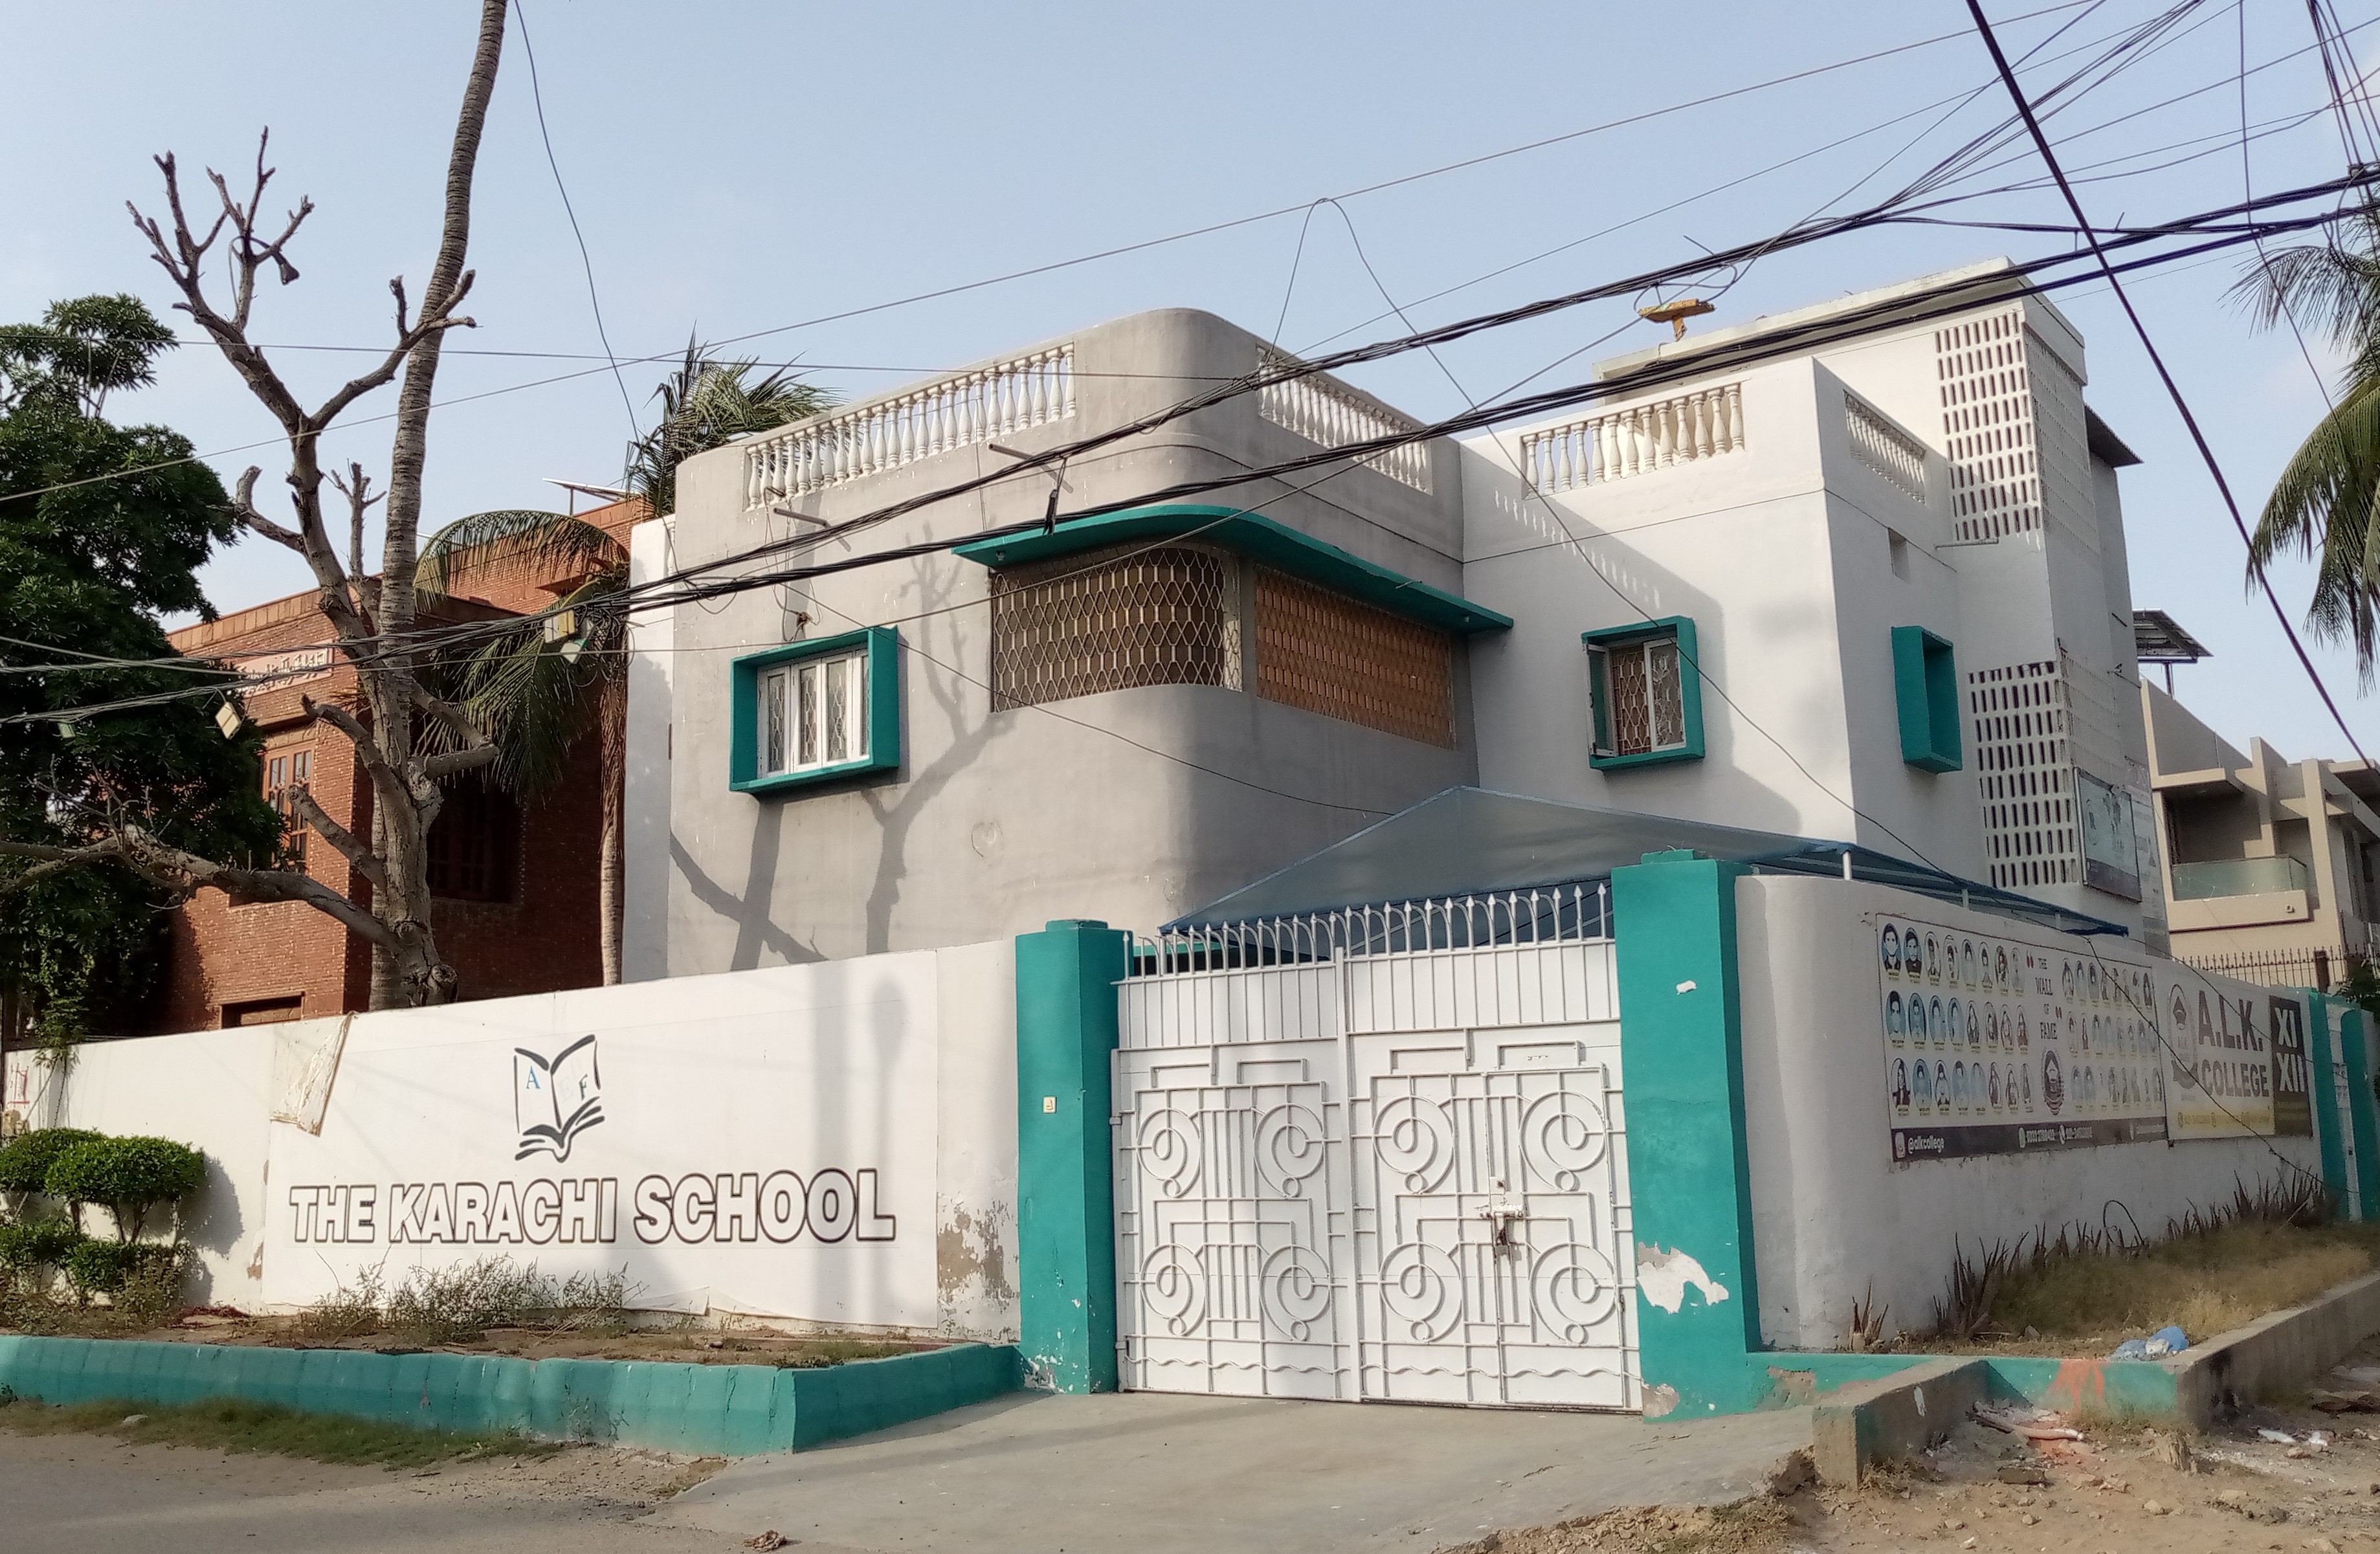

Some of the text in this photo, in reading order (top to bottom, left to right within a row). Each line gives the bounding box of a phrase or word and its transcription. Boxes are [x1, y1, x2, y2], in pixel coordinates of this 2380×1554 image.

[2035, 977, 2053, 995] WALL
[2040, 1021, 2058, 1039] FAME
[2198, 990, 2263, 1052] A.L.K.
[2274, 1006, 2298, 1049] XI
[526, 1065, 540, 1089] A
[579, 1073, 588, 1101] F
[2201, 1059, 2270, 1097] COLLEGE
[2276, 1051, 2306, 1093] XII
[290, 1168, 896, 1245] THE KARACHI SCHOOL
